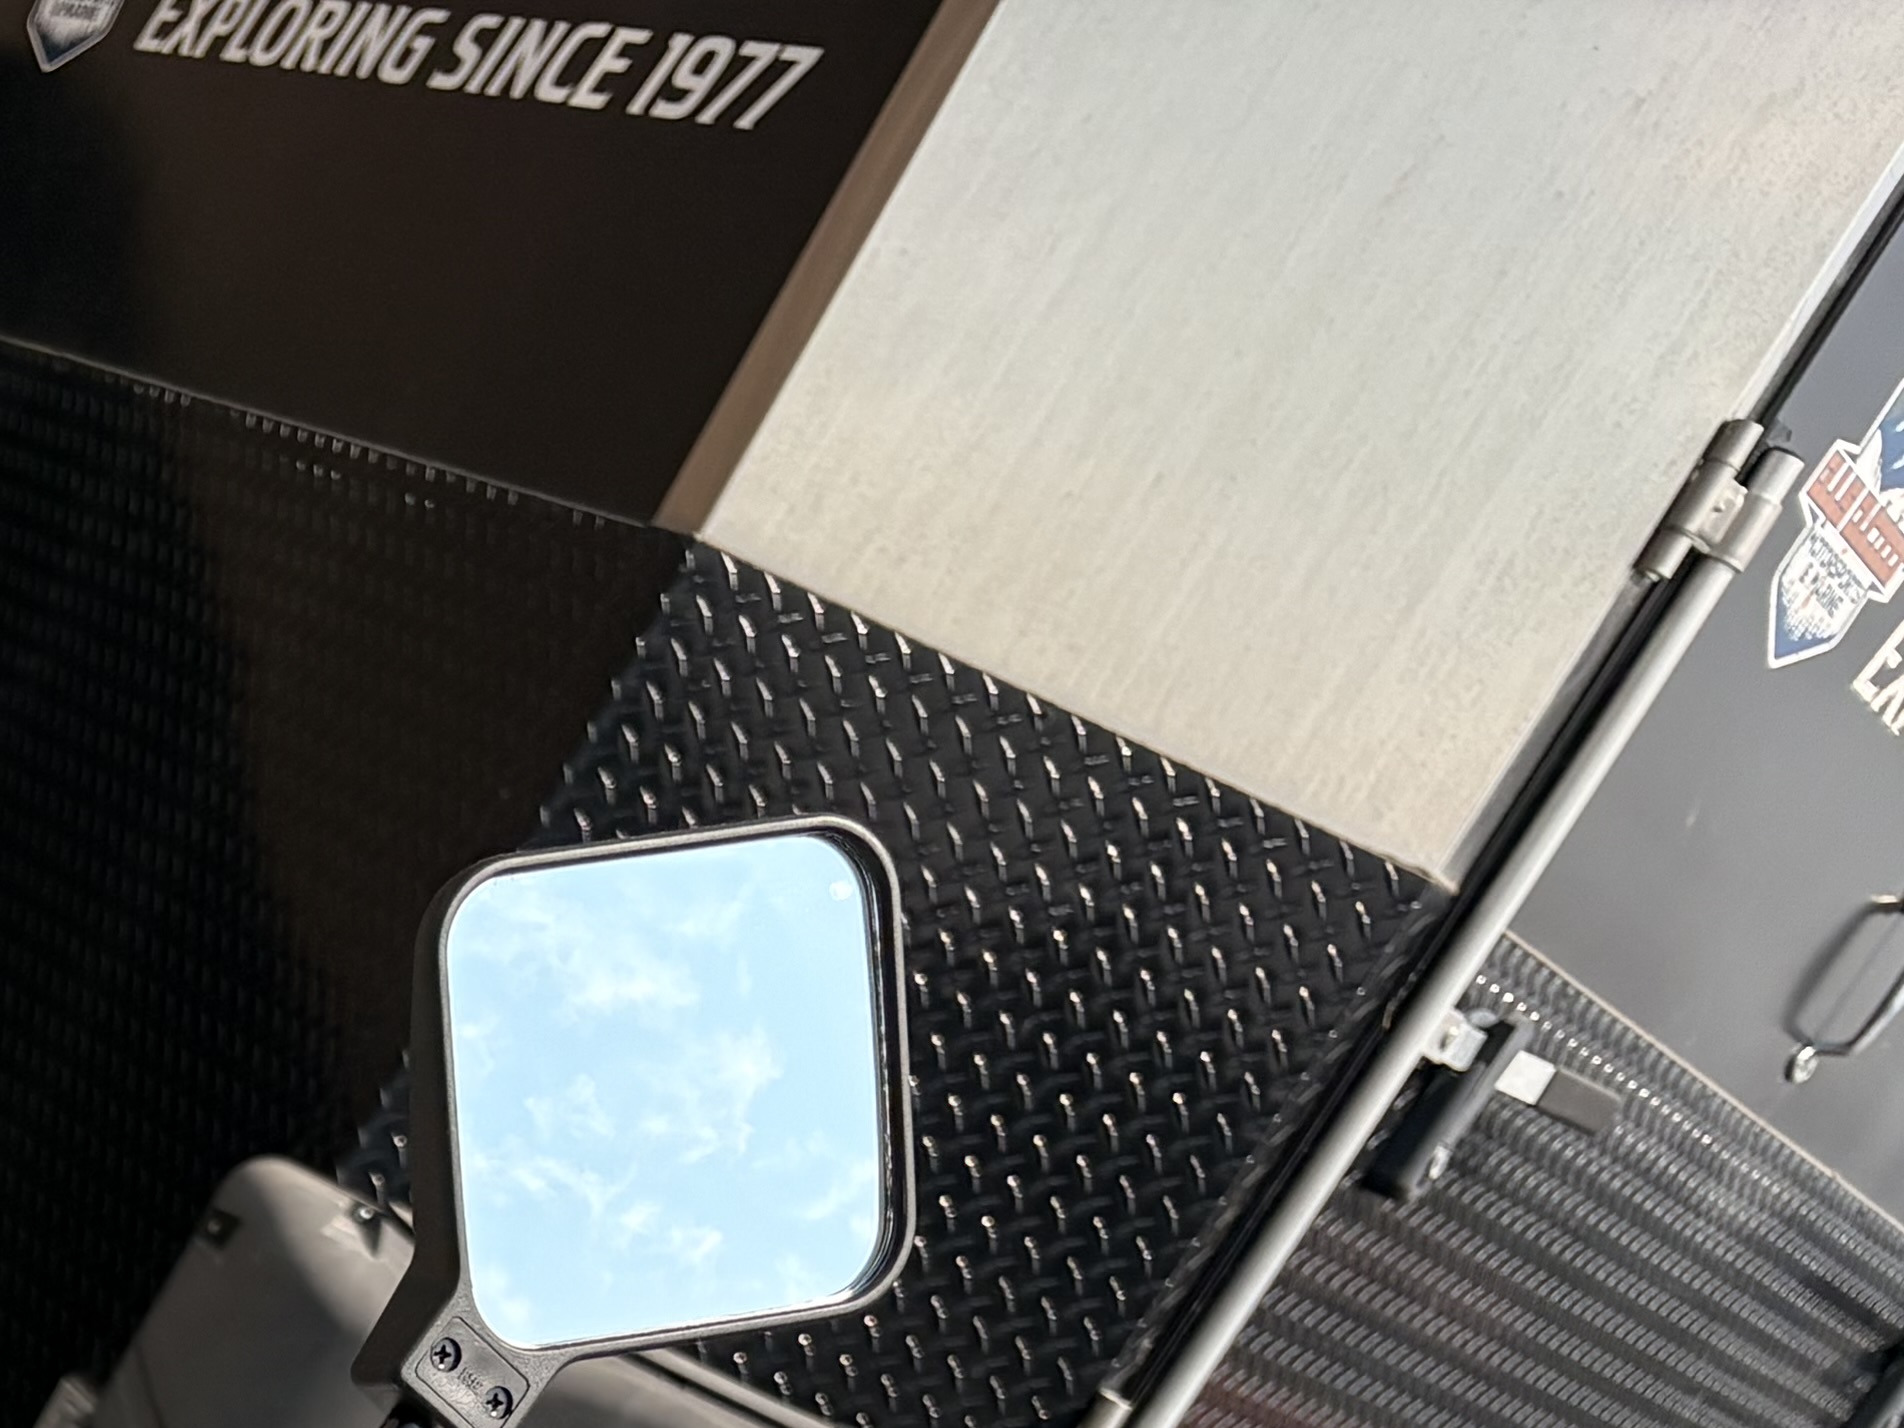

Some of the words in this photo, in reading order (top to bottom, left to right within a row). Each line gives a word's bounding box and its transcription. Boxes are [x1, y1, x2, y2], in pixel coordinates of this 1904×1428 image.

[133, 0, 450, 84] EXPLORING
[426, 14, 653, 110] SINCE
[626, 33, 824, 130] 1977
